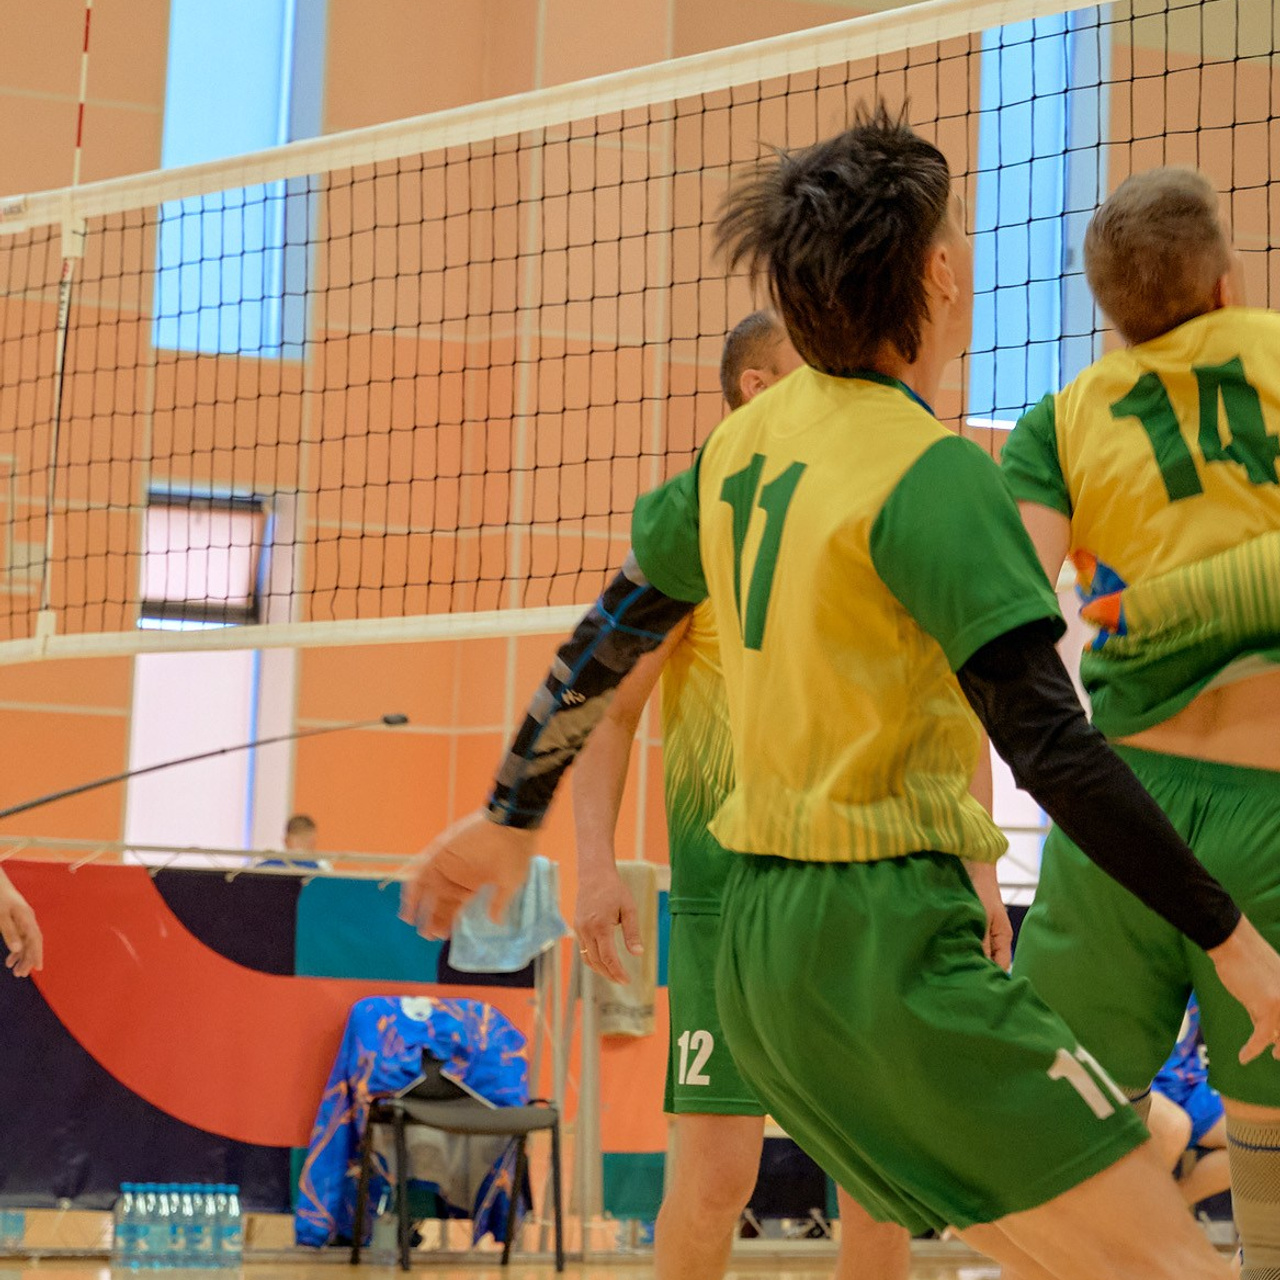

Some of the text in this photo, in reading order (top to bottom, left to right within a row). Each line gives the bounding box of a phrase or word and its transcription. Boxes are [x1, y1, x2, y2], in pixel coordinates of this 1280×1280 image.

[720, 453, 807, 651] 11
[677, 1030, 714, 1086] 12
[1046, 1042, 1131, 1120] 11
